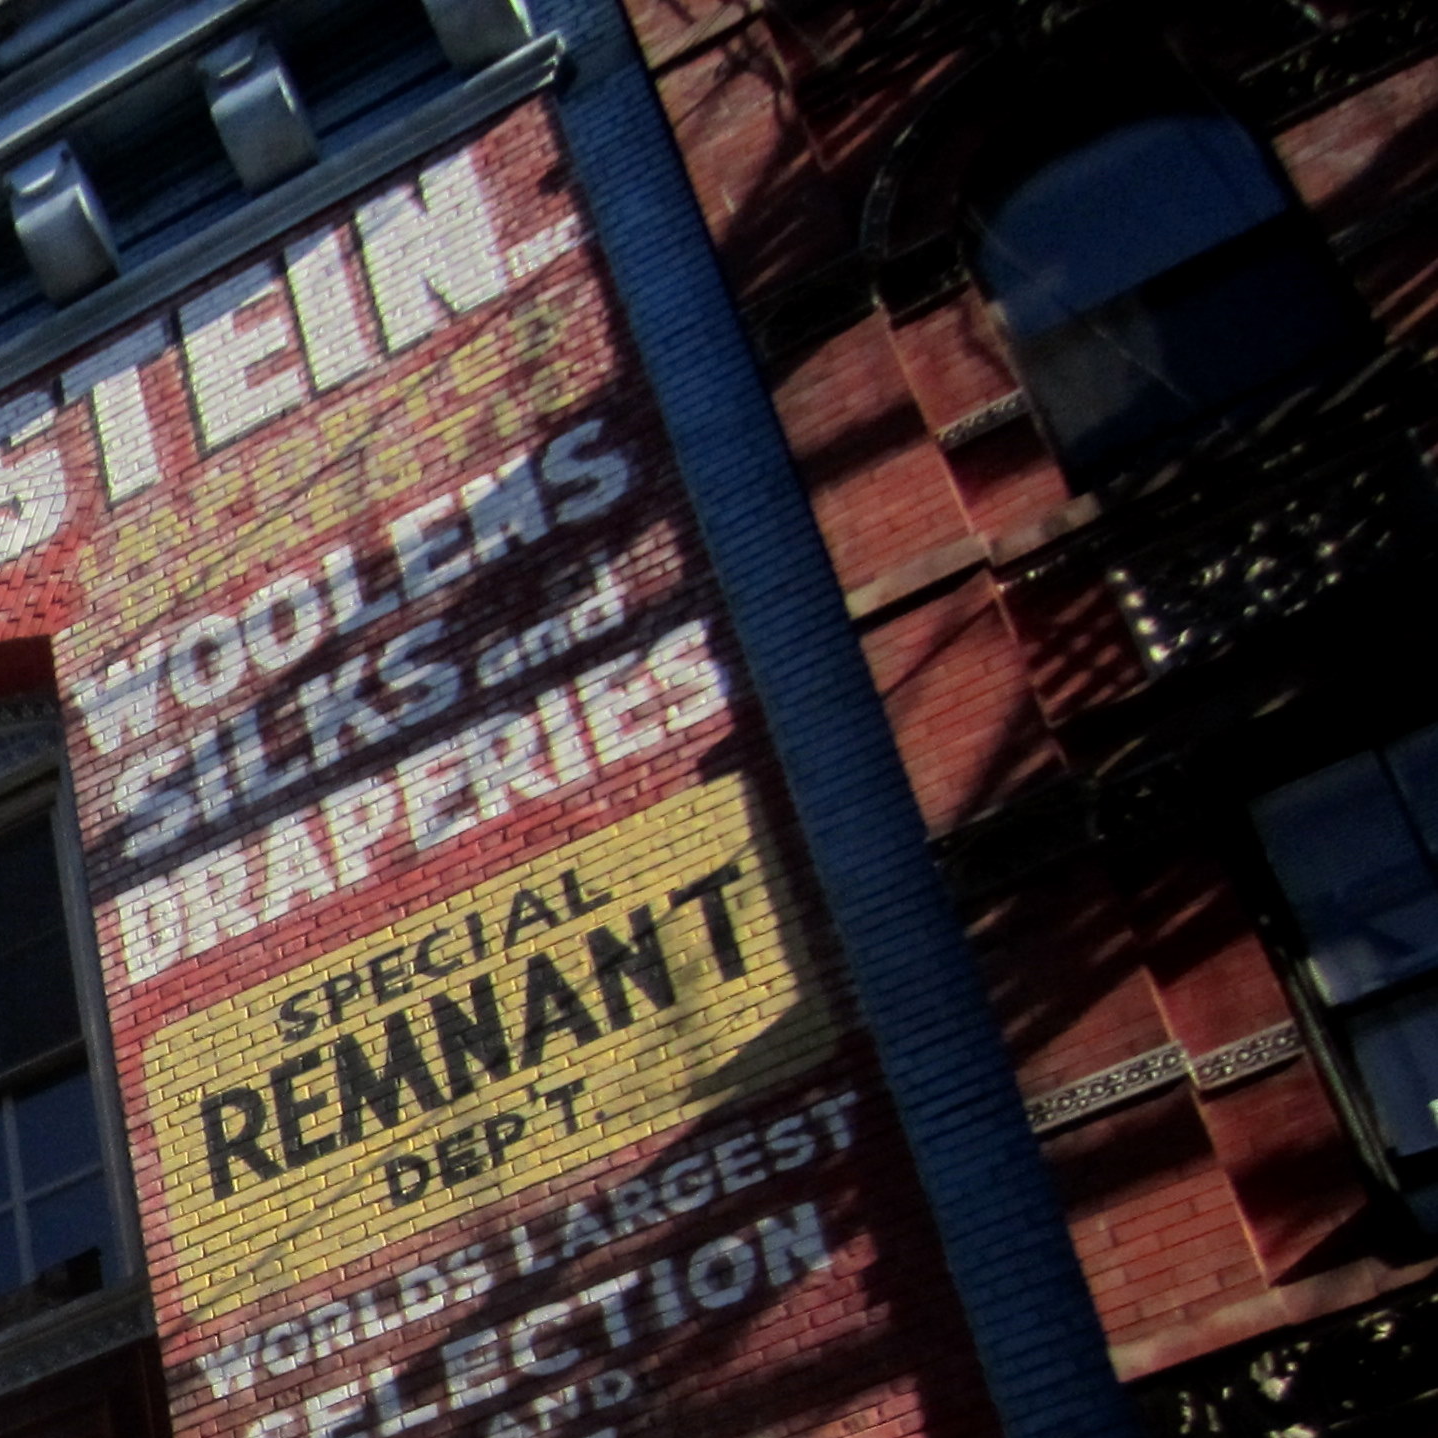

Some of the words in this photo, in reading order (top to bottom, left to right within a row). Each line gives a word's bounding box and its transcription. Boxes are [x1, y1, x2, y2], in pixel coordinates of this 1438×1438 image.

[72, 418, 637, 754] WOOLENS
[113, 619, 460, 859] SILKS
[477, 550, 627, 687] and
[116, 617, 729, 984] DRAPERIES
[280, 868, 612, 1044] SPECIAL
[202, 866, 752, 1200] REMNANT
[196, 1244, 493, 1399] WORLDS
[512, 1091, 859, 1276] LARGEST
